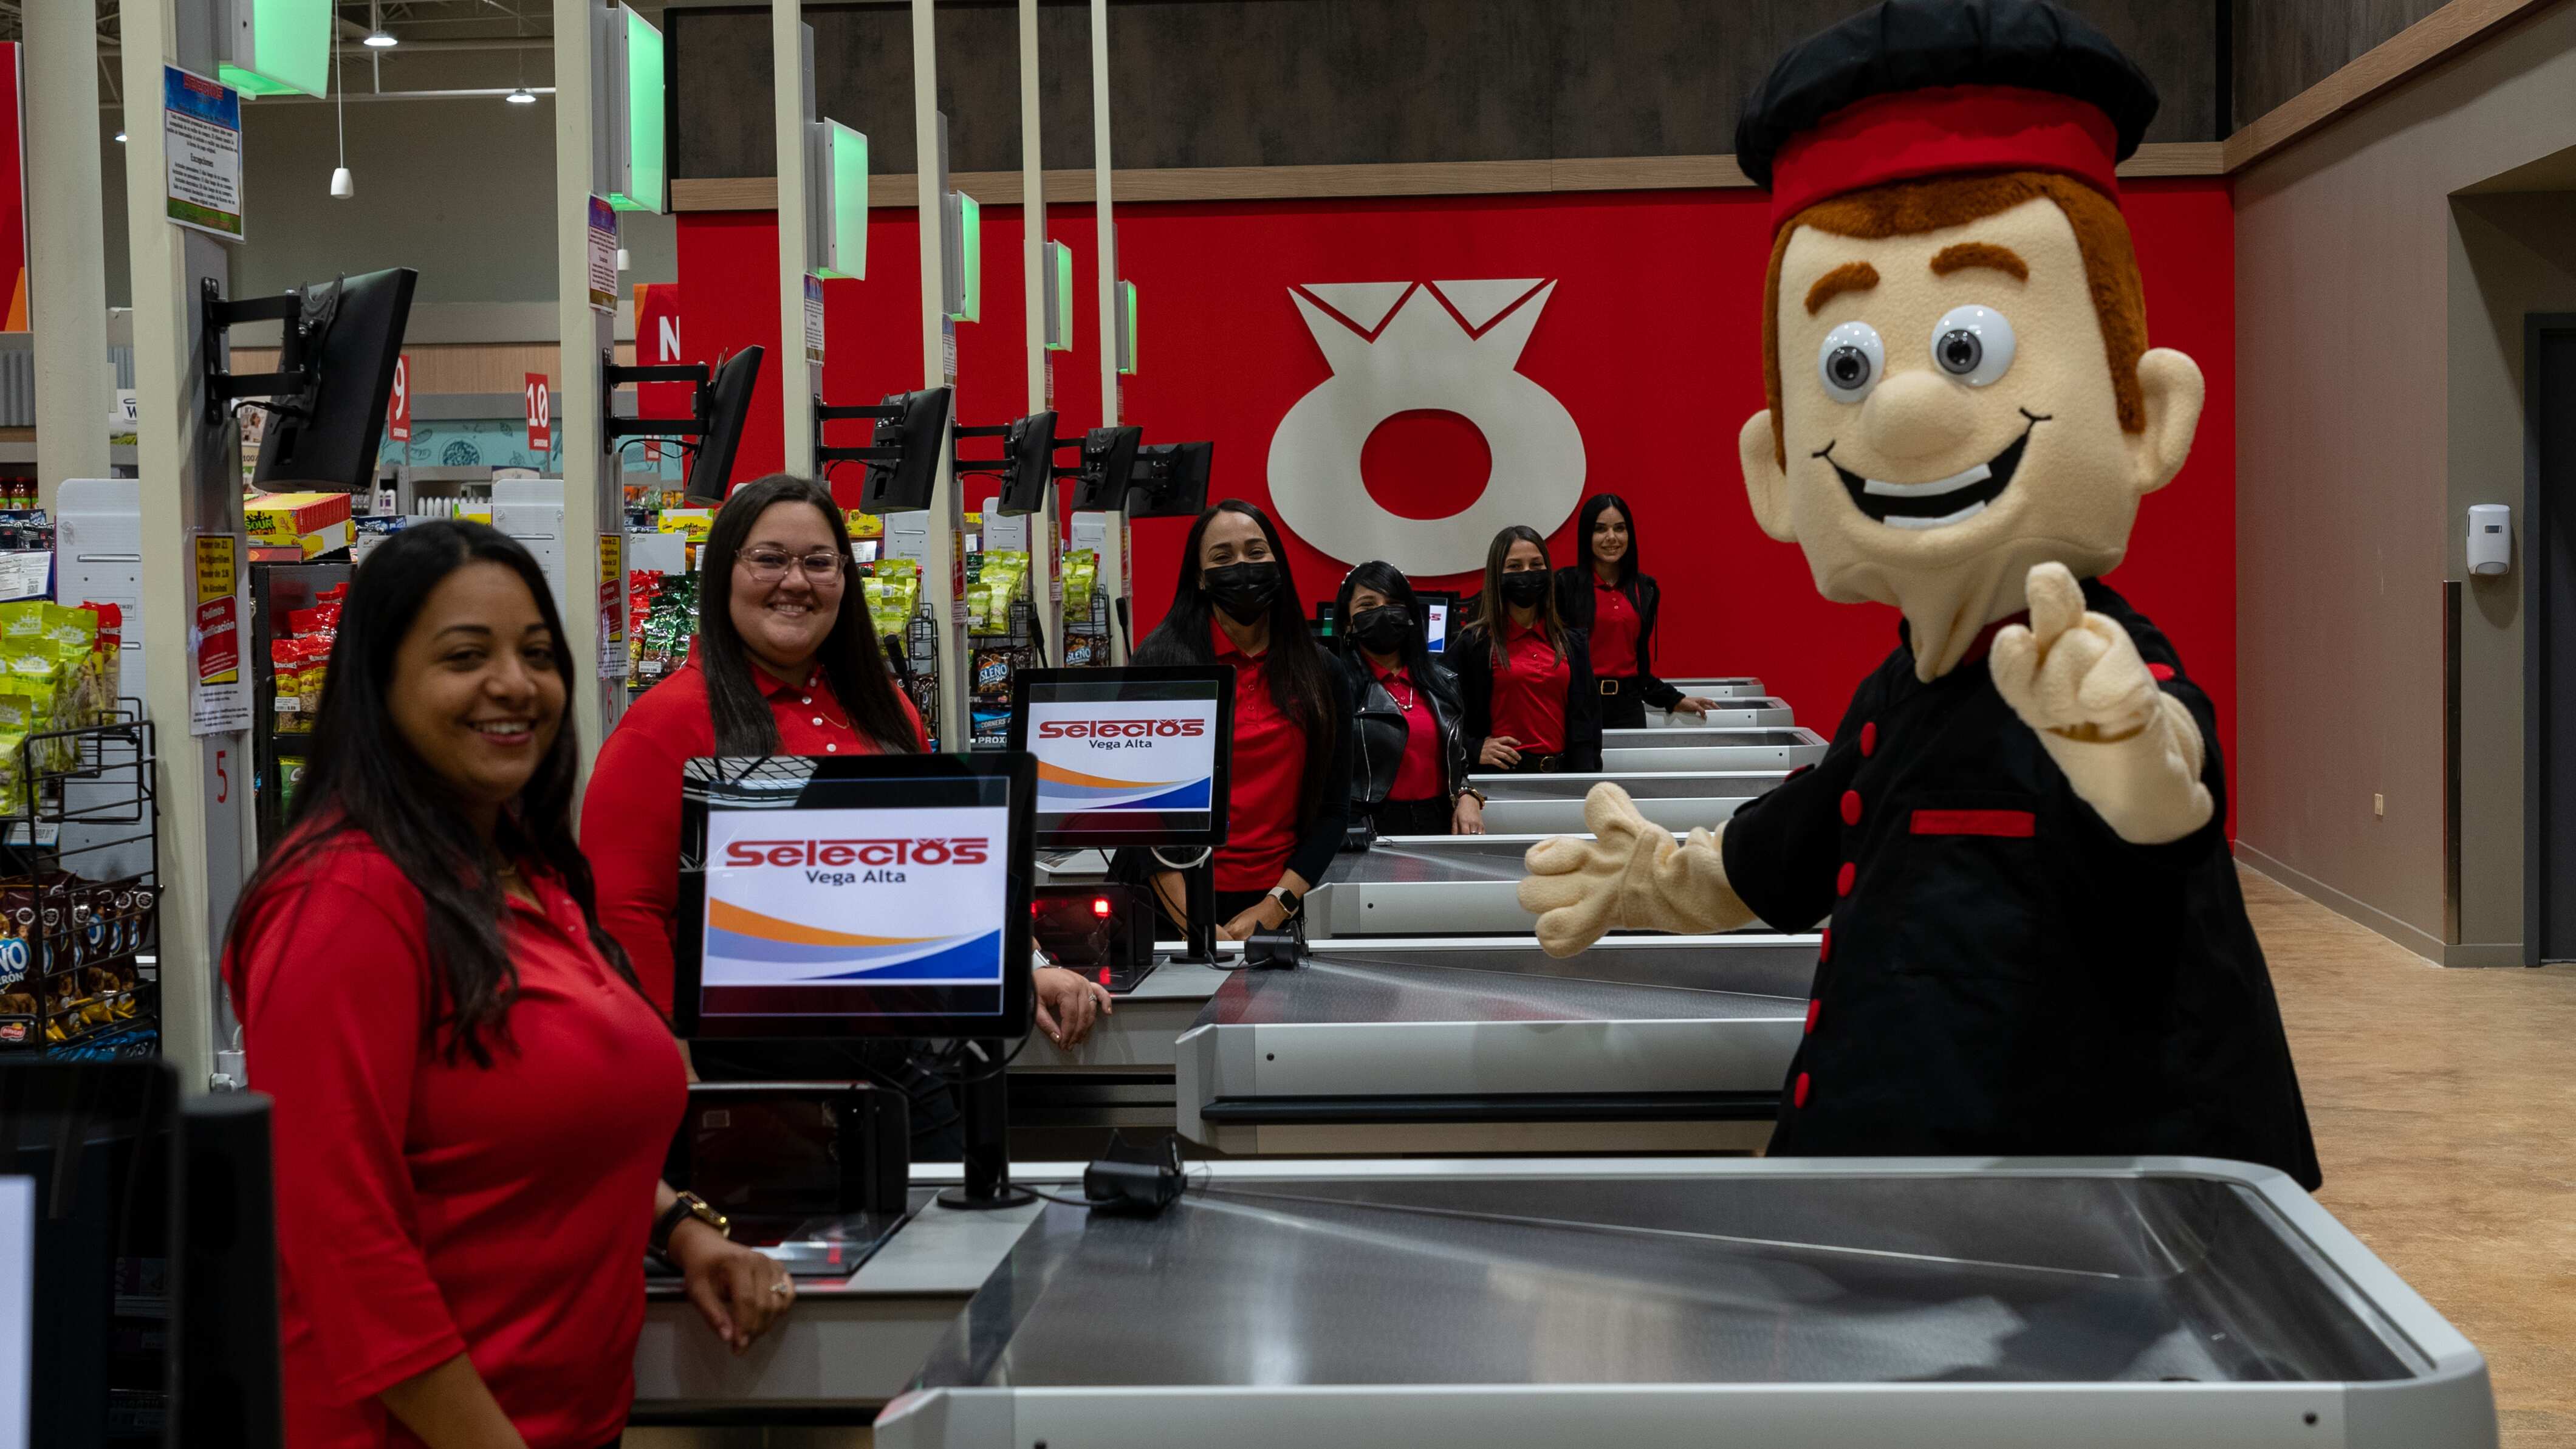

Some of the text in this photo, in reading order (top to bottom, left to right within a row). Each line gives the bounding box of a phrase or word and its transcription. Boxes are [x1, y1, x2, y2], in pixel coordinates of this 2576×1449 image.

[394, 357, 405, 420] 9
[527, 383, 547, 428] 10
[606, 686, 613, 725] 6
[1089, 739, 1153, 750] Vega Alta
[216, 750, 228, 804] 5
[806, 869, 907, 886] Vega Alta
